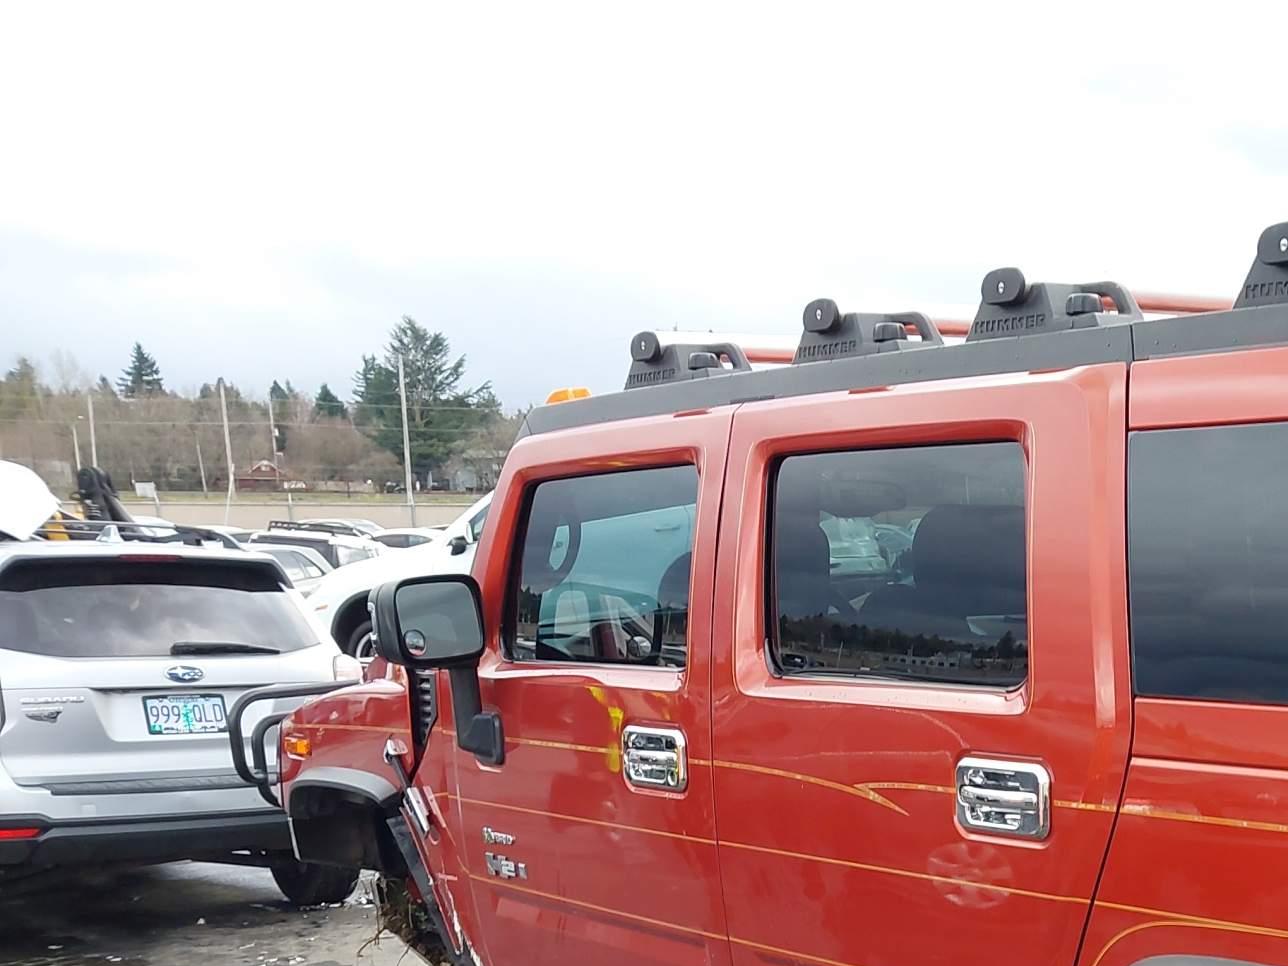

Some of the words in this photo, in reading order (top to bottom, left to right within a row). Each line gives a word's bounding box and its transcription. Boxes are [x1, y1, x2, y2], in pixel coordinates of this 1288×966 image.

[974, 313, 1046, 334] HUMMER
[800, 339, 858, 359] HUMMER
[628, 367, 677, 386] HUMMER
[149, 704, 181, 724] 999
